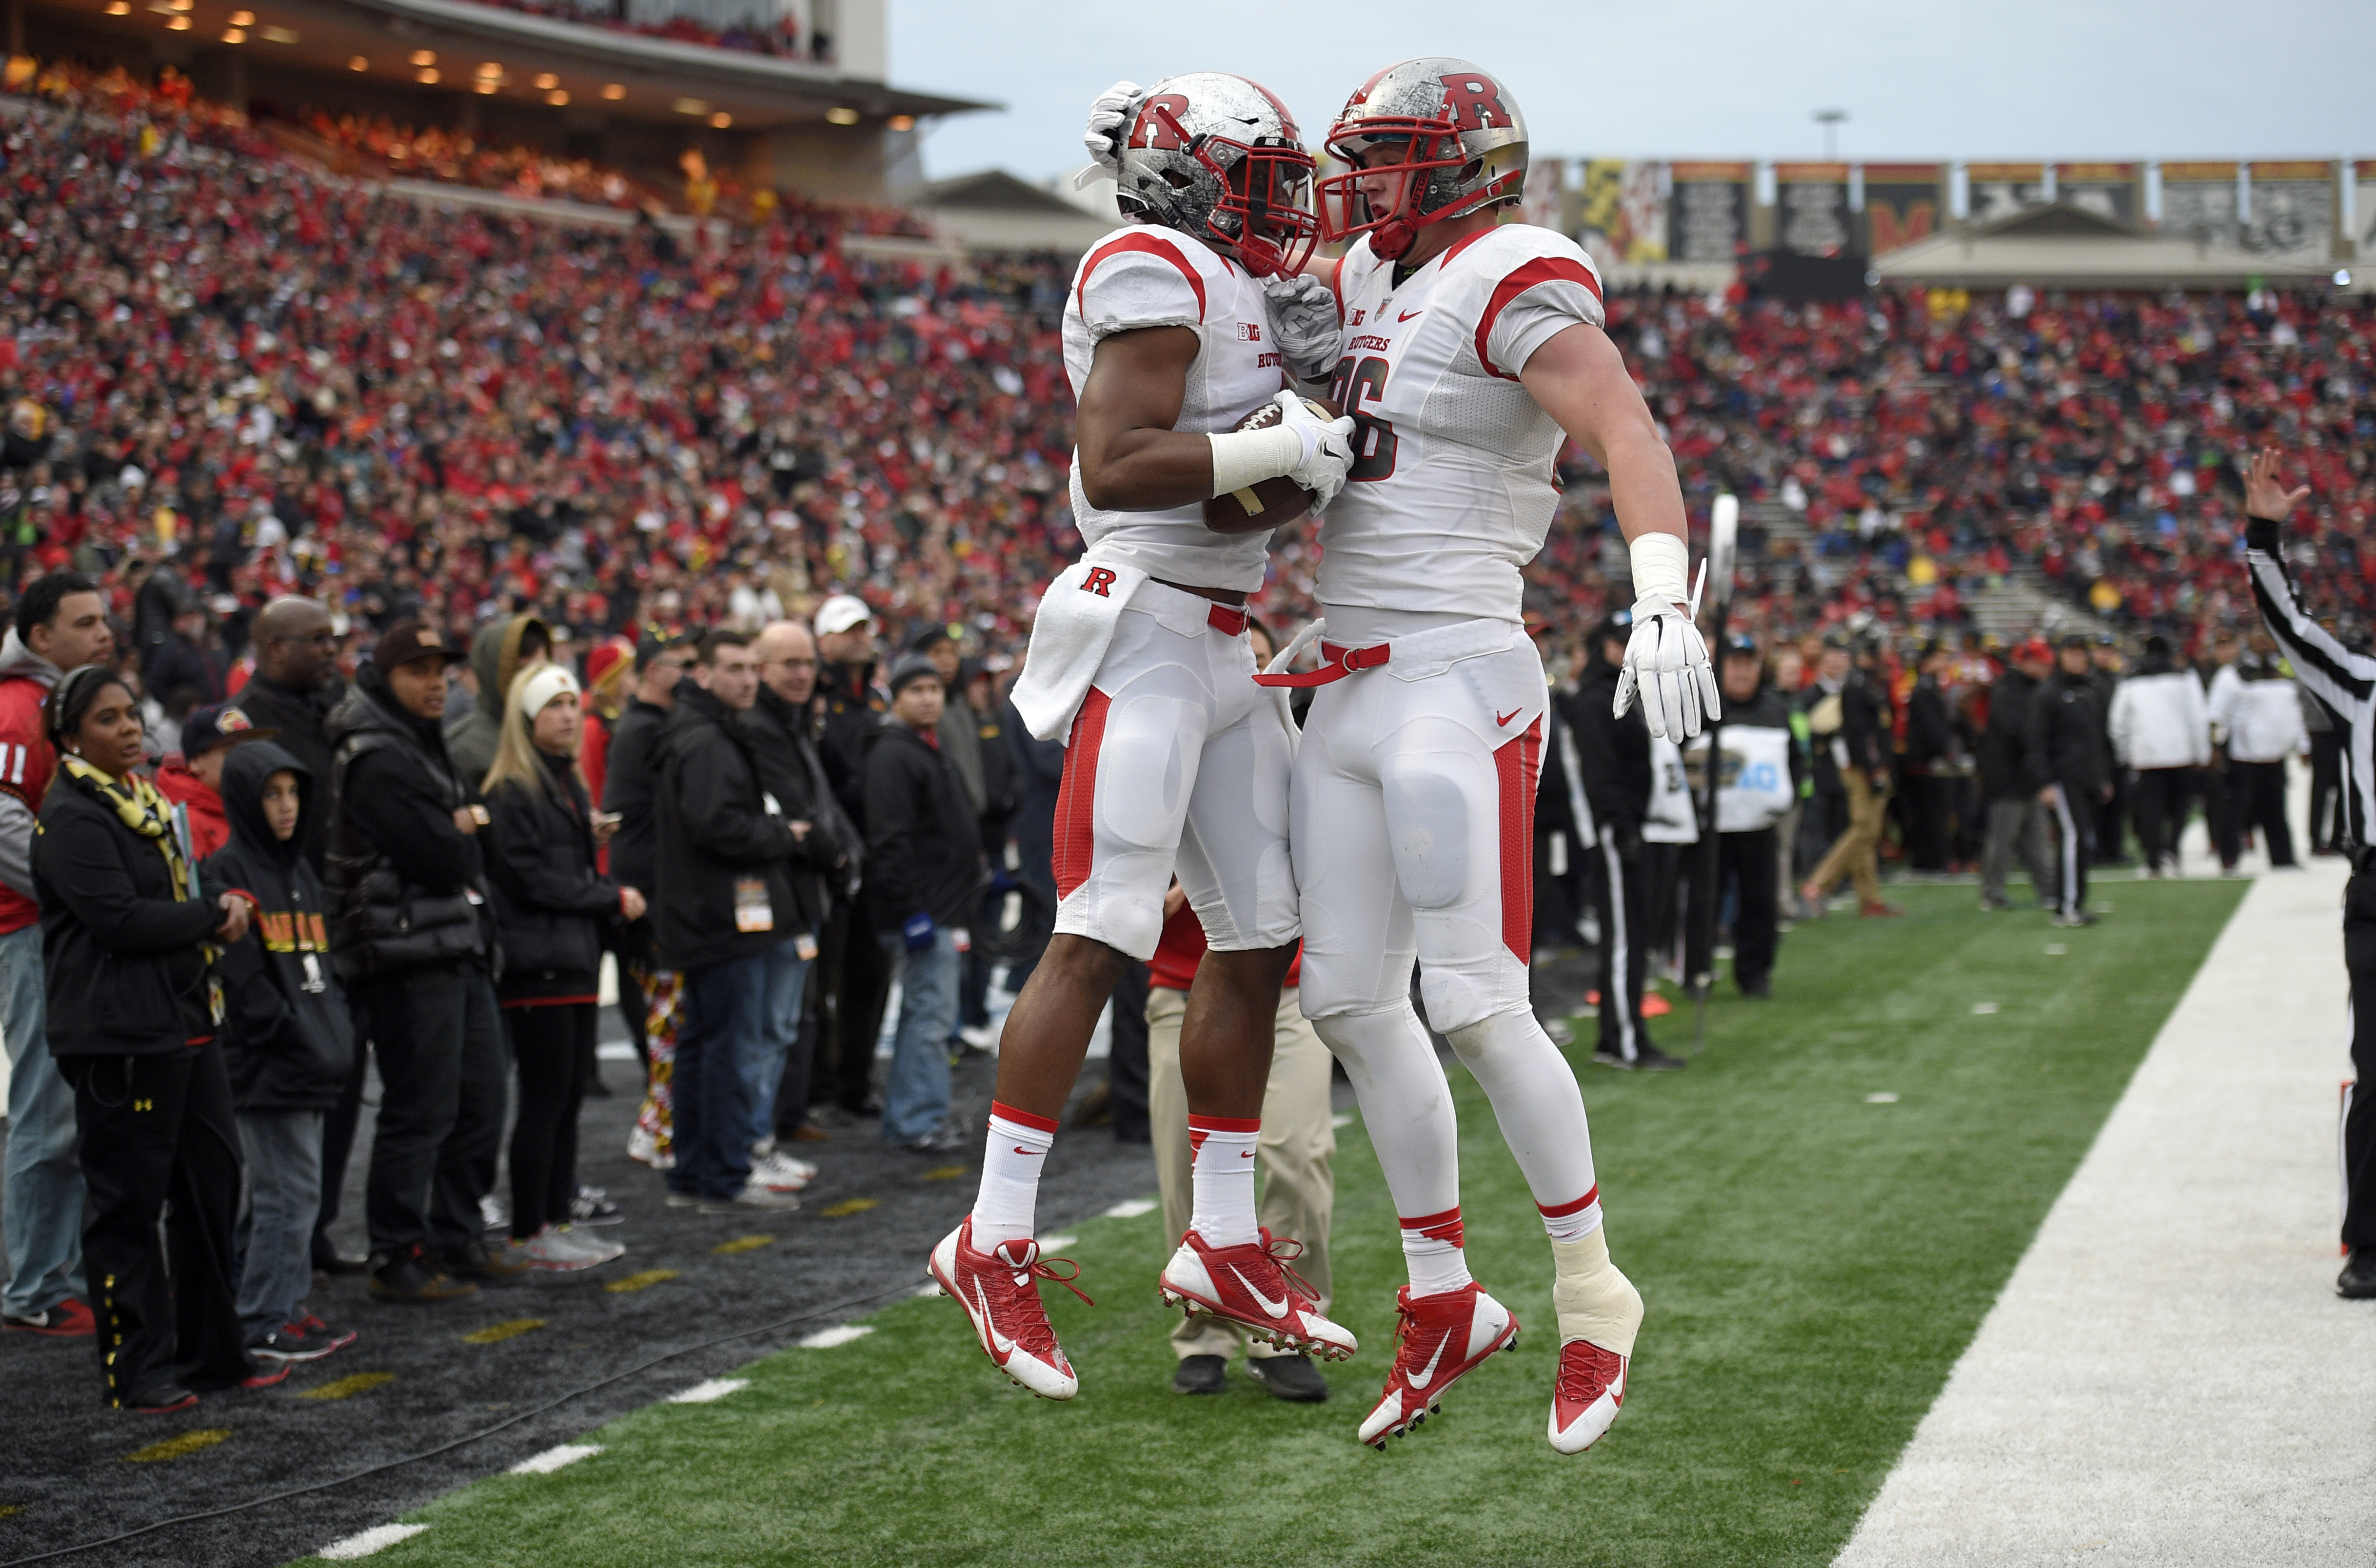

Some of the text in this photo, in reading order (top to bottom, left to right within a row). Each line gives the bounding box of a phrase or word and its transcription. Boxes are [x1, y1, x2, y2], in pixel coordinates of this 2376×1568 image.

[1439, 73, 1513, 132] R
[1128, 94, 1189, 150] R
[1264, 137, 1280, 146] NIKE
[1347, 335, 1391, 352] RUTGERS
[1079, 567, 1117, 598] R
